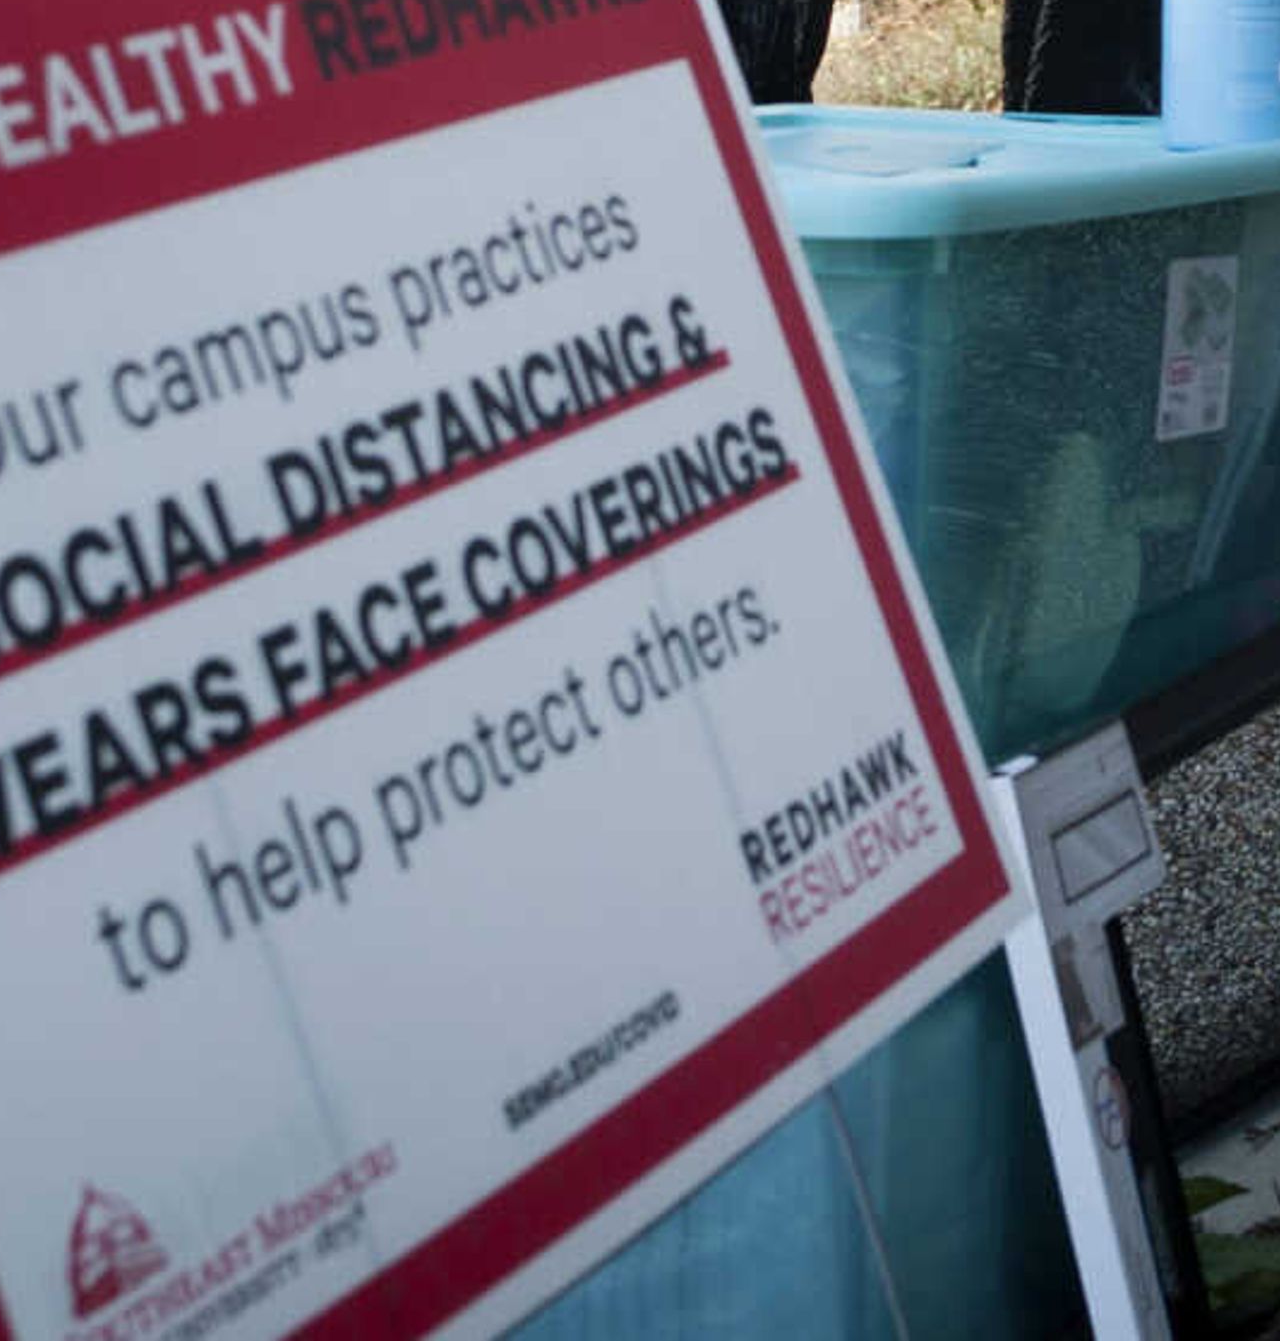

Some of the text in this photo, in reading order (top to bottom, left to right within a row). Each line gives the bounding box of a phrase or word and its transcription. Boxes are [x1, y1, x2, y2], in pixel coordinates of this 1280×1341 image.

[111, 284, 381, 429] campus
[389, 192, 639, 334] practices
[265, 315, 663, 537] DISTANCING
[667, 294, 711, 371] &
[257, 560, 459, 720] FACE
[460, 406, 789, 621] COVERINGS
[97, 587, 781, 992] to help protect others.
[738, 731, 919, 884] REDHAWK
[757, 785, 941, 944] RESILIENCE
